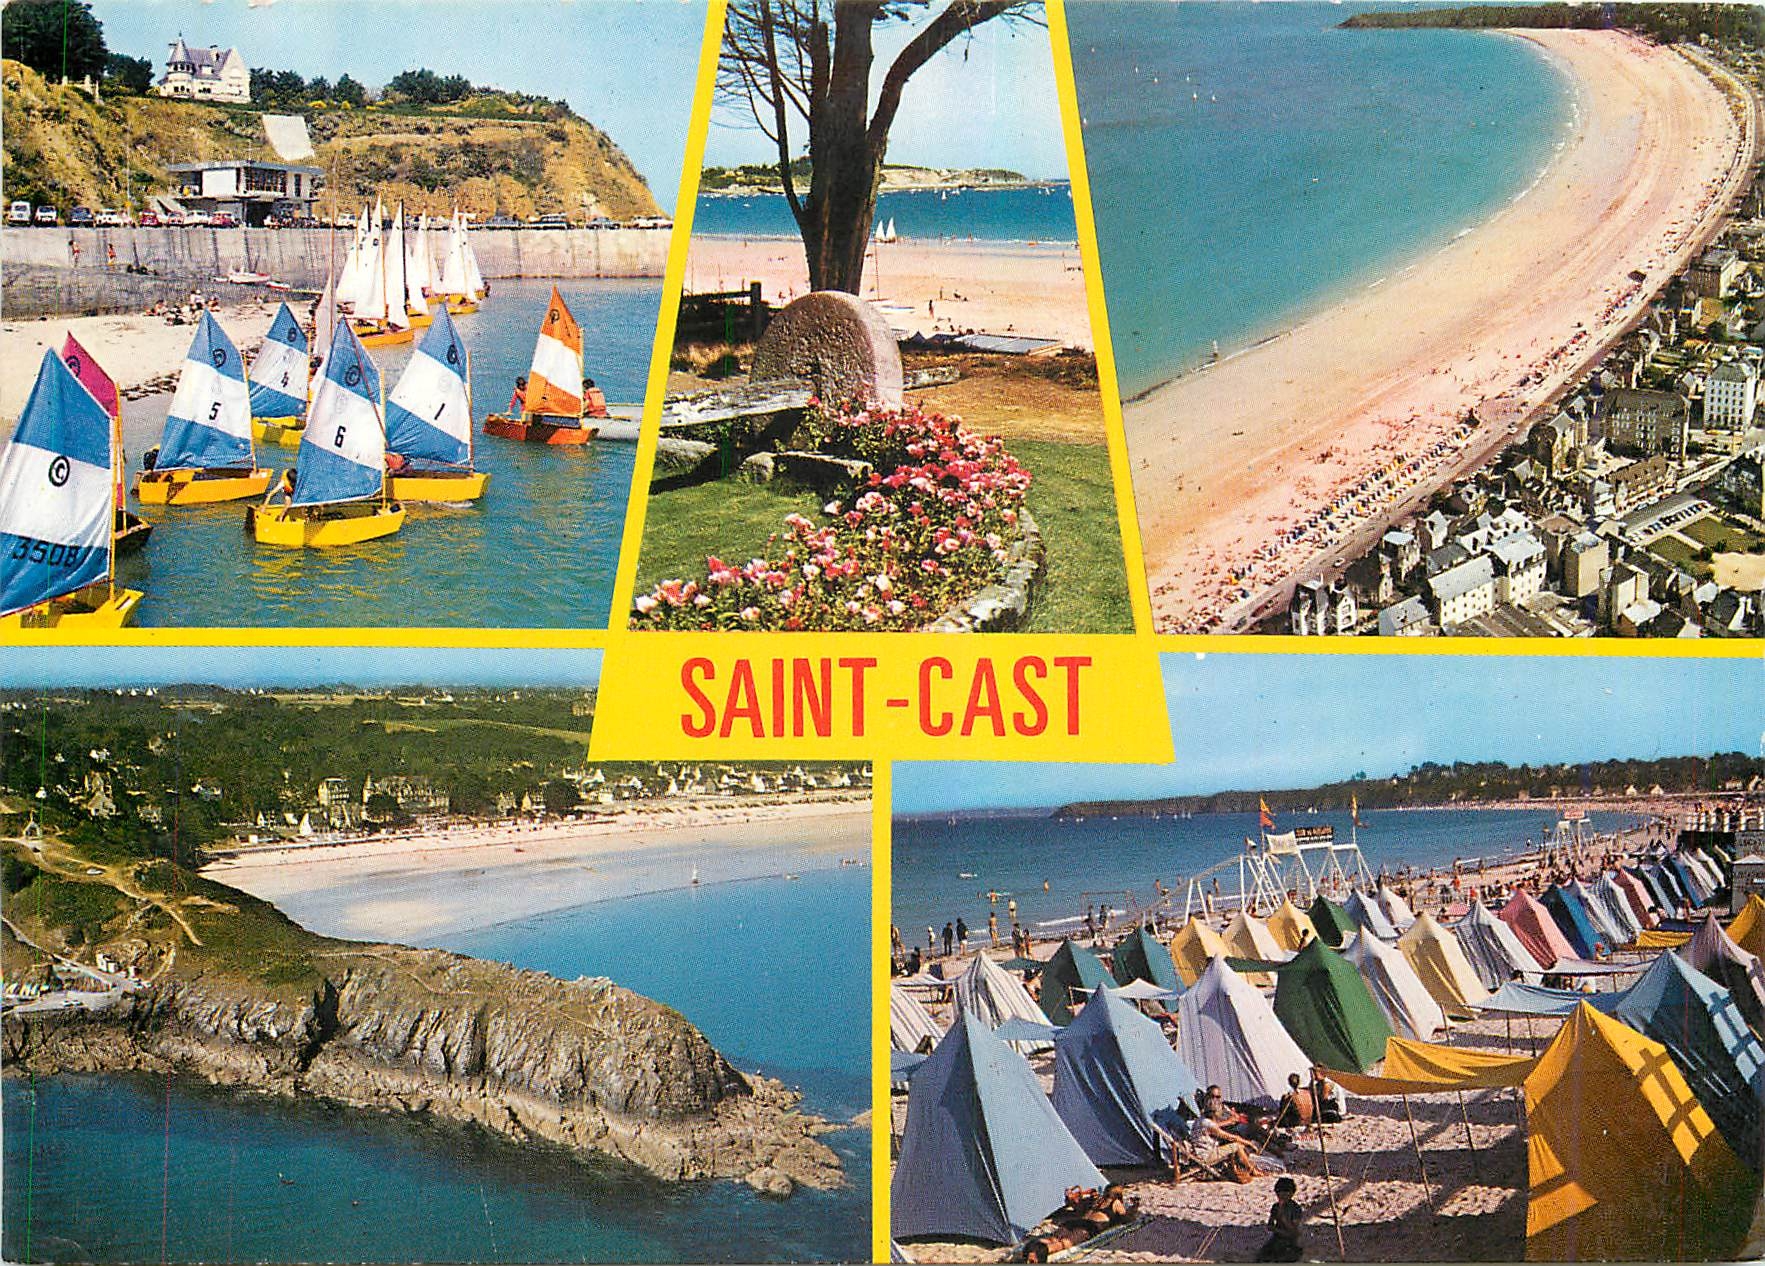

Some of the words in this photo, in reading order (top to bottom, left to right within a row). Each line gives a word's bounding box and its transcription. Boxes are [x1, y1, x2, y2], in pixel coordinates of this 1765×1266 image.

[209, 401, 222, 421] 5
[434, 403, 446, 420] 1
[334, 425, 347, 449] 6
